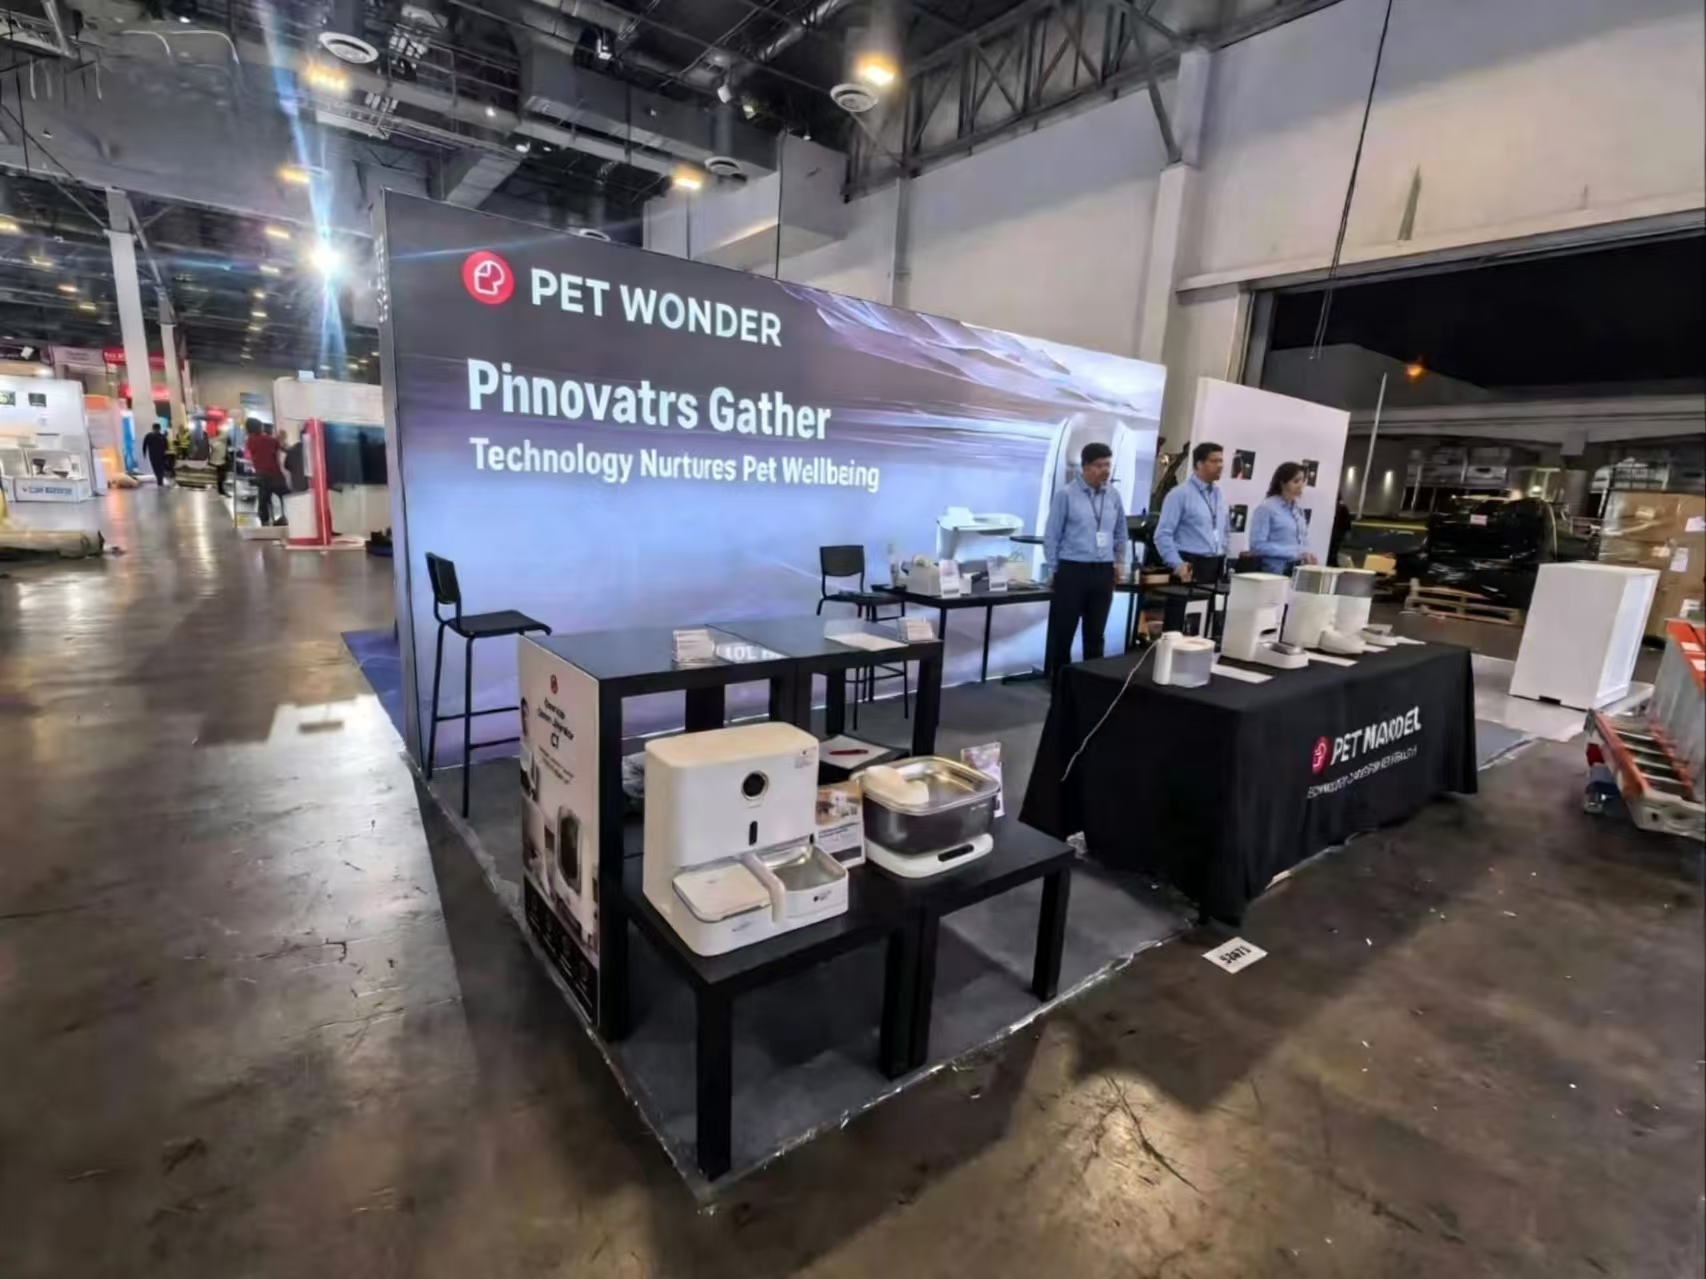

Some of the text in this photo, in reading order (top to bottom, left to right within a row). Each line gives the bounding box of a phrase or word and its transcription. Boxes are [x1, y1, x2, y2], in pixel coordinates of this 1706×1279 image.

[530, 267, 783, 347] PET WONDER
[467, 358, 832, 440] Pinnovatrs Gather
[469, 437, 881, 493] Technology Nurtures Pet Wellbeing
[1330, 728, 1363, 766] PET
